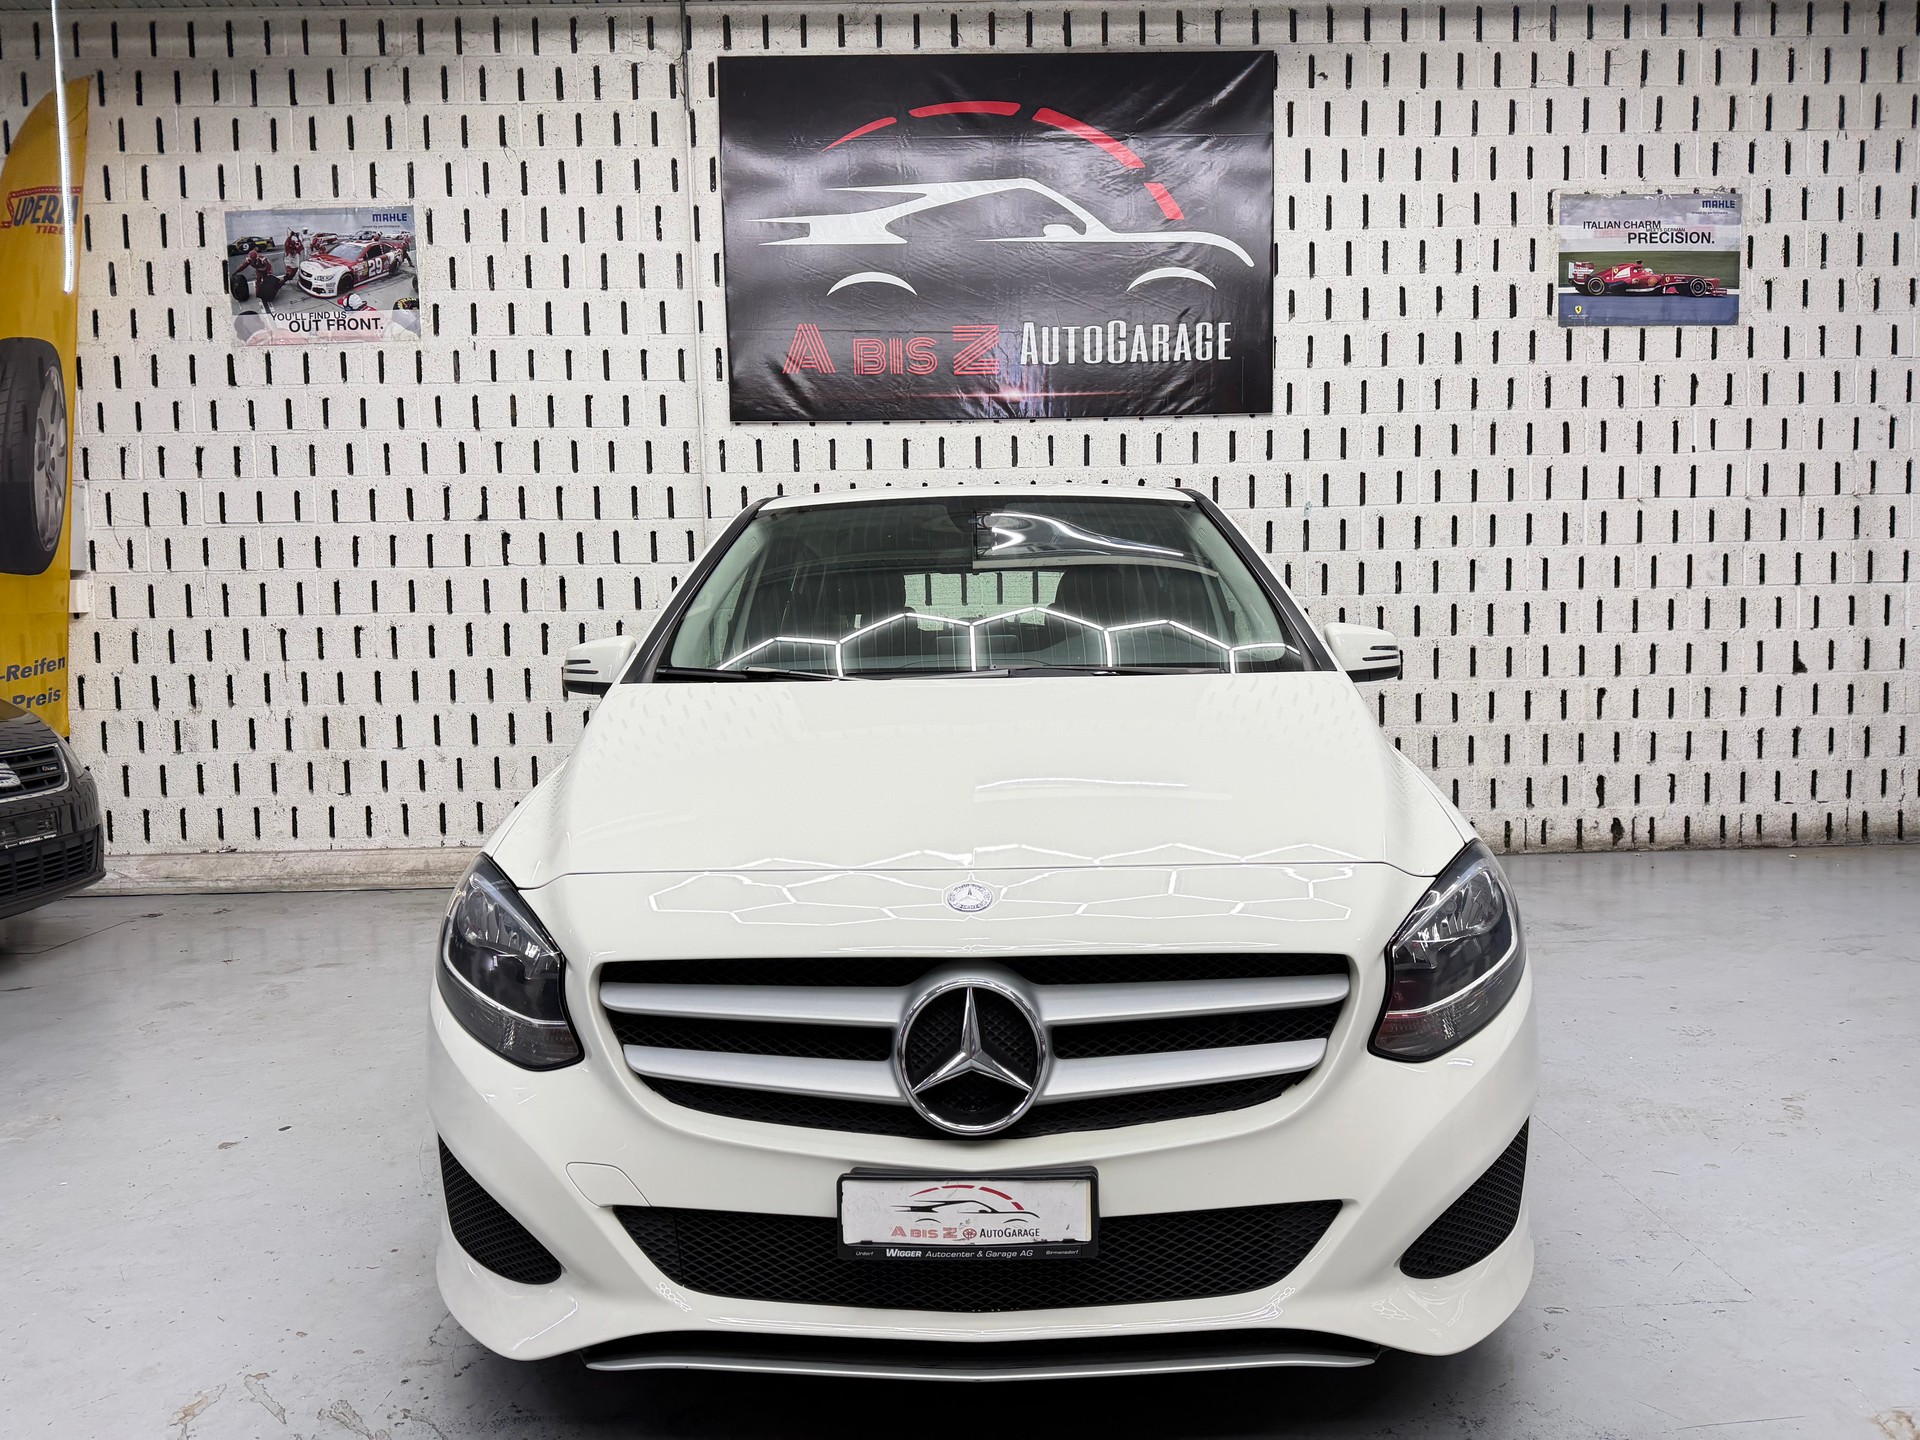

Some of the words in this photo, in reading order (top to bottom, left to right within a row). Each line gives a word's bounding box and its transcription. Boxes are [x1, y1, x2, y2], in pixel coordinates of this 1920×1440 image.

[0, 186, 81, 227] SUPER
[1702, 200, 1736, 209] MAHLE
[372, 213, 408, 222] MAHLE
[1583, 221, 1621, 230] ITALIAN
[1623, 220, 1662, 229] CHARM
[1627, 231, 1716, 244] PRECISION.
[367, 257, 383, 277] 29
[271, 313, 307, 321] YOU'LL
[309, 311, 331, 320] FIND
[333, 311, 347, 319] US
[289, 319, 322, 333] OUT
[326, 317, 384, 331] FRONT.
[782, 323, 836, 374] A
[952, 324, 1000, 376] Z
[12, 687, 61, 709] Preis
[890, 1225, 907, 1237] A
[942, 1227, 958, 1239] Z
[925, 1250, 975, 1258] Autocenter
[985, 1250, 1017, 1259] Garage
[1019, 1249, 1034, 1257] AG
